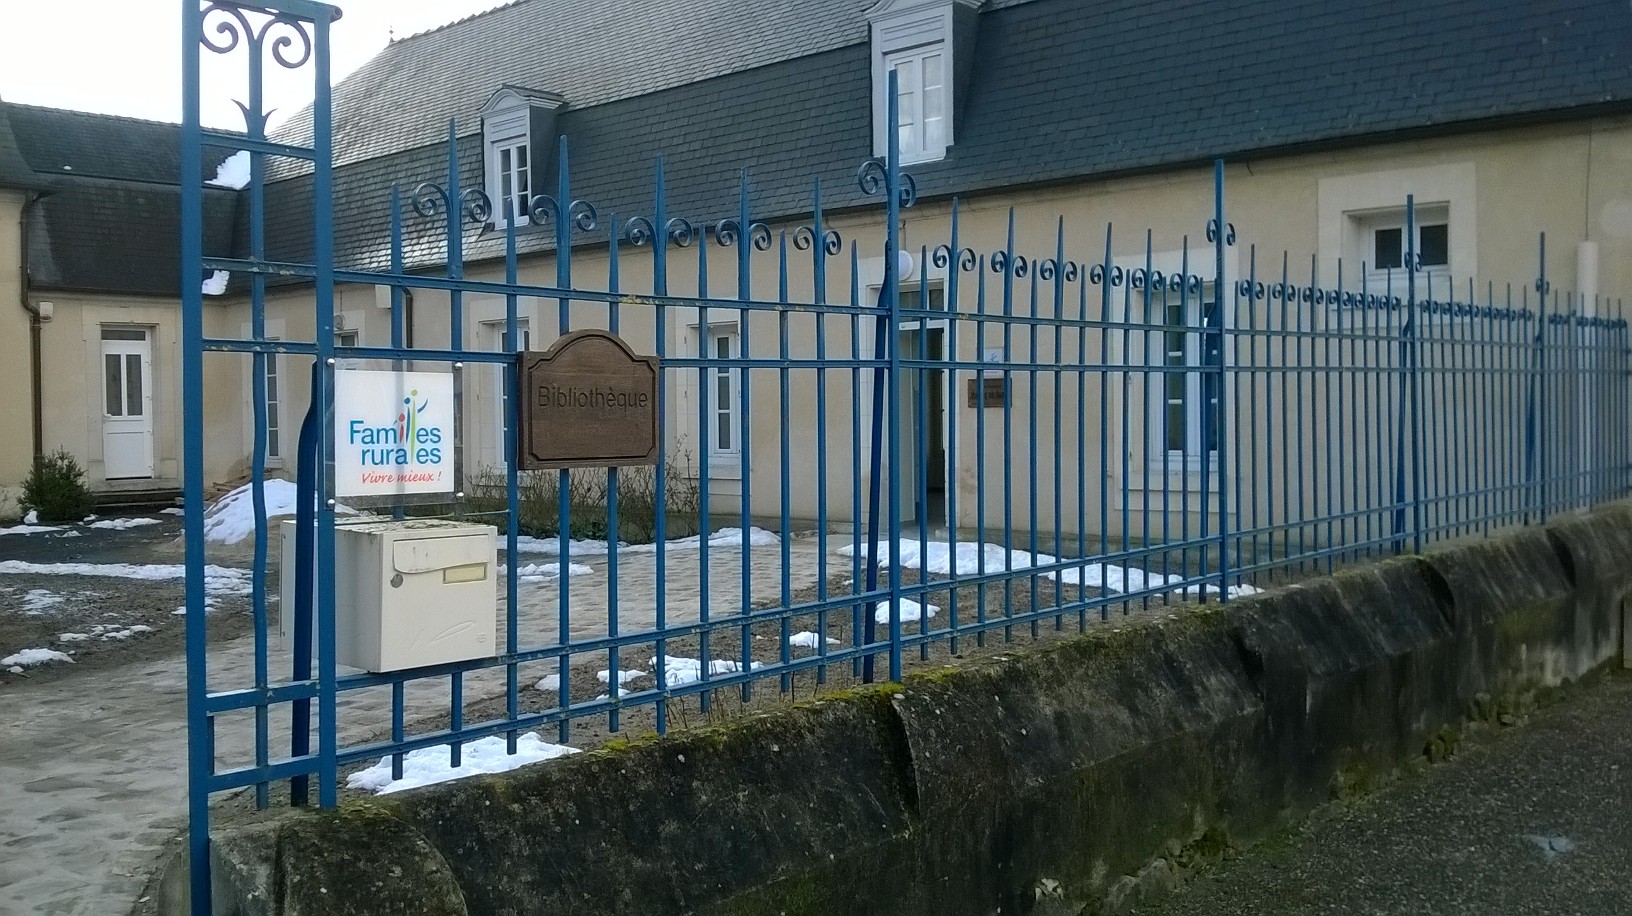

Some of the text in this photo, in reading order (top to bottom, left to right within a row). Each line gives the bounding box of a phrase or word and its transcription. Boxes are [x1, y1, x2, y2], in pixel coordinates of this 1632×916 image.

[538, 386, 648, 412] Bibliothèque
[349, 400, 441, 444] Familles
[361, 447, 441, 465] rurales
[362, 471, 395, 484] Vivre
[396, 470, 434, 483] mieux
